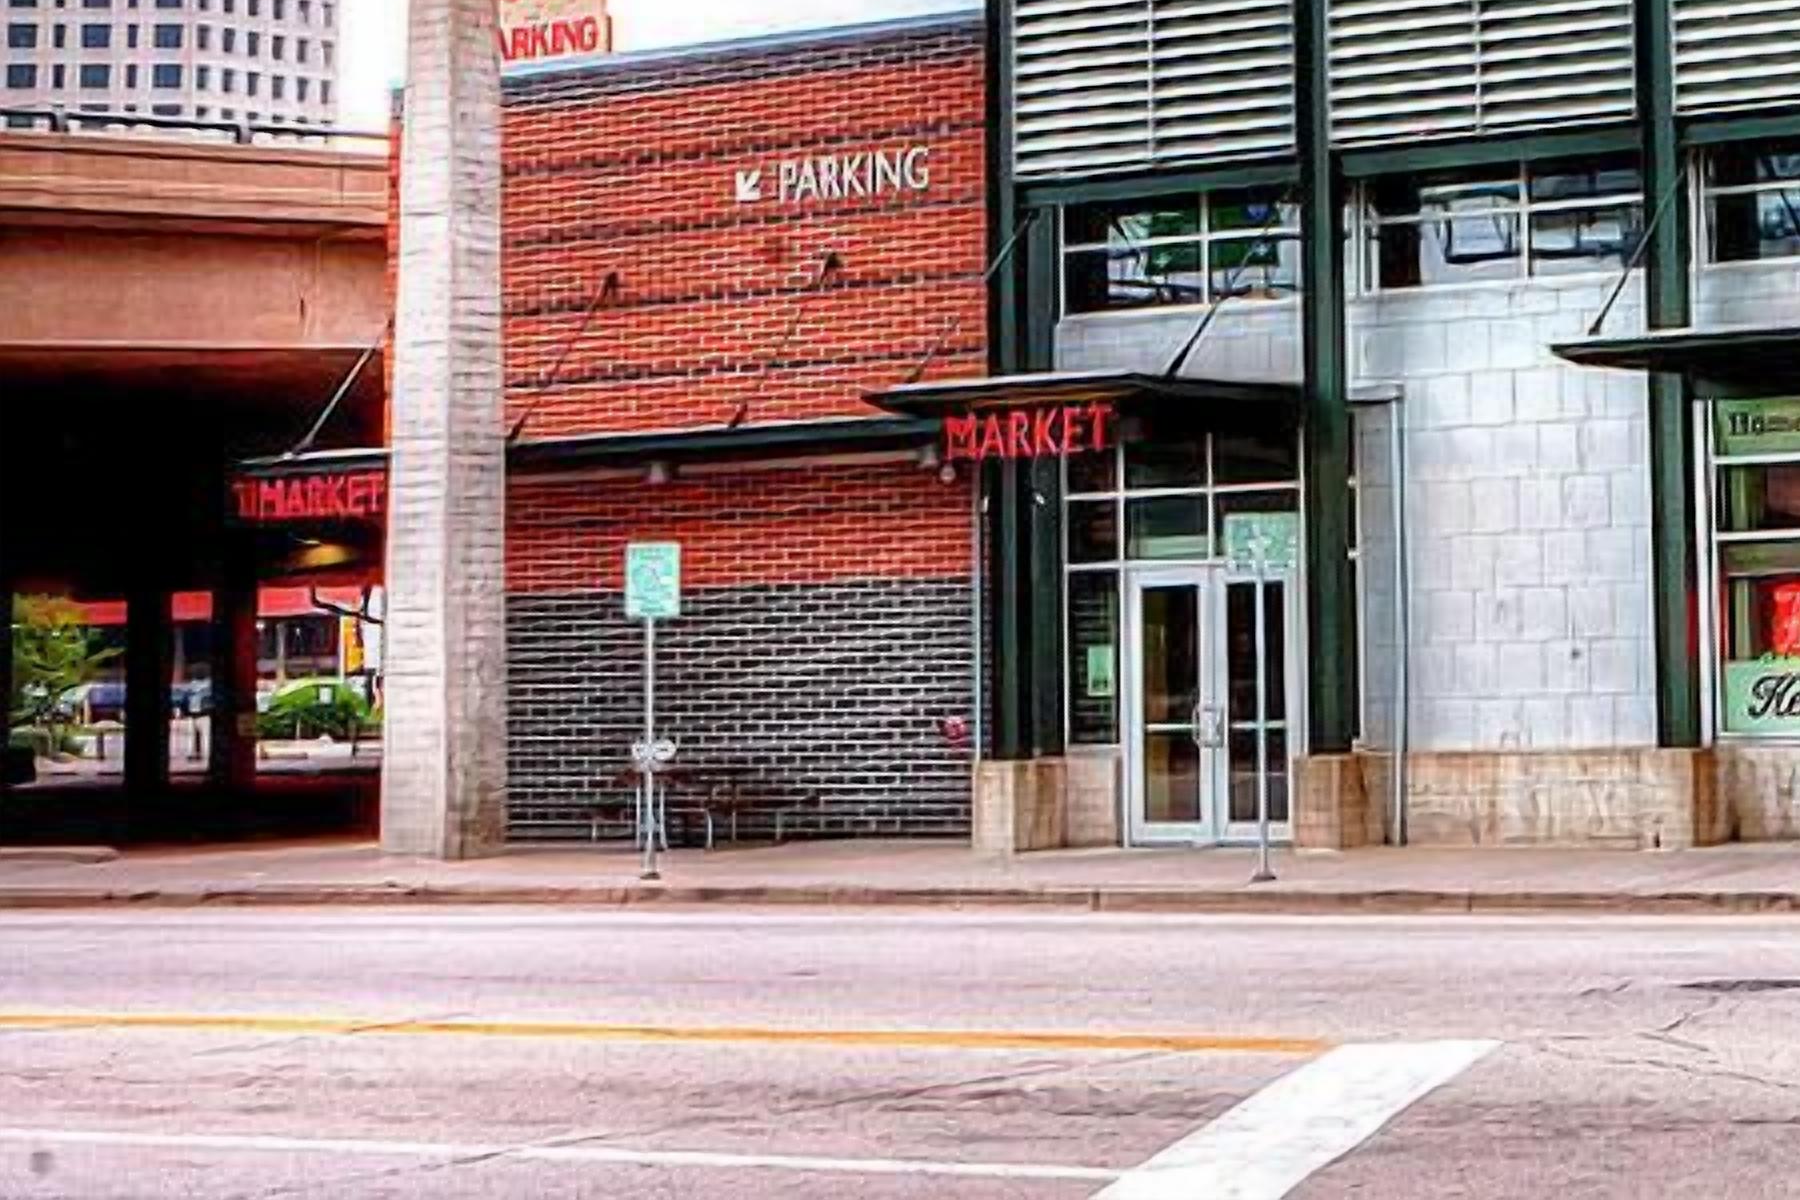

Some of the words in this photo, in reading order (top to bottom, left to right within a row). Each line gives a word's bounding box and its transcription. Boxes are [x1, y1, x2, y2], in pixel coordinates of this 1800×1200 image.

[779, 145, 930, 204] PARKING
[943, 402, 1113, 461] MARKET
[258, 470, 386, 519] MARKET
